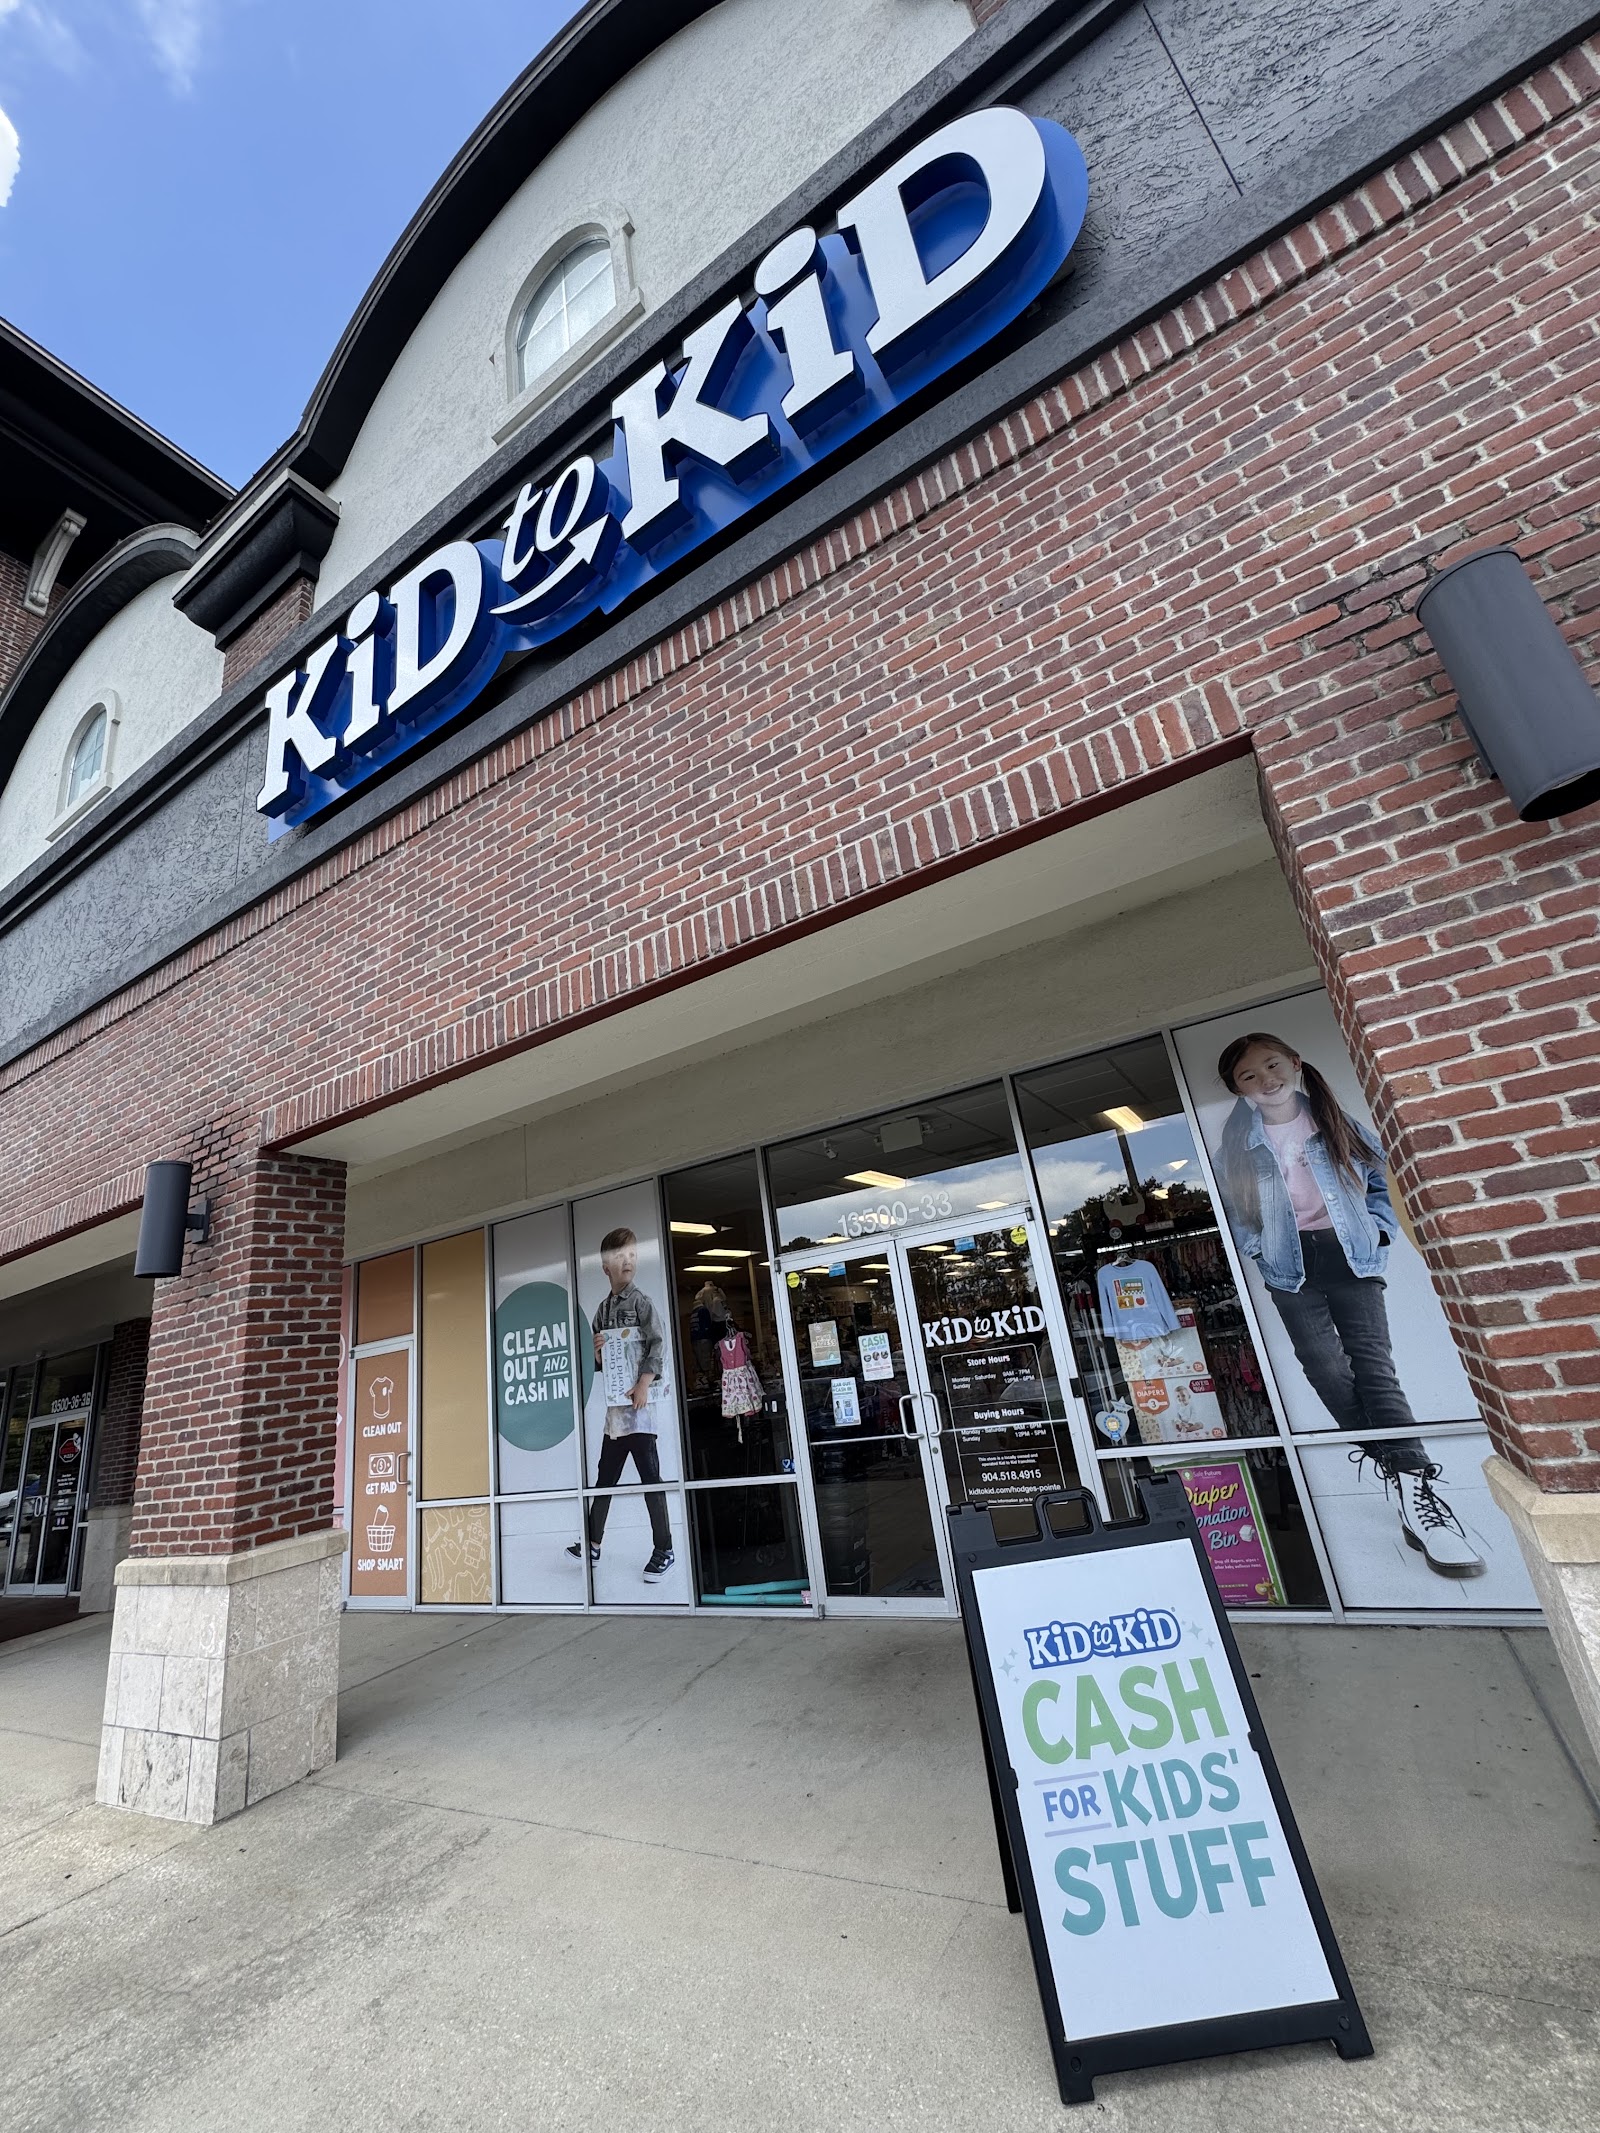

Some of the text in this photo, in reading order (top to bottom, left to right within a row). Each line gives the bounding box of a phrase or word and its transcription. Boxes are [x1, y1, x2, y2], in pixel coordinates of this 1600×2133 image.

[500, 455, 596, 584] to
[838, 1191, 952, 1238] 13500-33
[974, 1316, 990, 1334] to
[503, 1322, 567, 1356] CLEAN
[861, 1334, 886, 1348] CASH
[503, 1355, 568, 1383] OUT AND
[967, 1355, 1011, 1367] Store Hours
[610, 1374, 618, 1394] The
[617, 1365, 625, 1396] World
[951, 1375, 971, 1383] Monday
[974, 1373, 997, 1381] Saturday
[1018, 1368, 1031, 1376] 7PM
[953, 1382, 971, 1390] Sunday
[1004, 1376, 1019, 1384] 12PM
[505, 1377, 569, 1406] CASH IN
[1137, 1388, 1165, 1398] DIAPERS
[1151, 1400, 1157, 1409] 3
[973, 1408, 1025, 1420] Buying Hours
[363, 1421, 402, 1438] CLEAN OUT
[962, 1435, 981, 1443] Sunday
[1034, 1429, 1047, 1437] 5PM
[981, 1469, 1042, 1482] 904.518.4915
[366, 1481, 397, 1495] GET PAID
[968, 1483, 1061, 1496] kidtokid.com/hodges-pointe
[1195, 1505, 1250, 1529] onation
[1208, 1530, 1239, 1551] Bin
[357, 1557, 404, 1571] SHOP SMART
[1092, 1622, 1113, 1646] to
[1021, 1657, 1232, 1765] CASH
[1043, 1747, 1241, 1829] FOR KIDS'
[1054, 1820, 1276, 1937] STUFF
